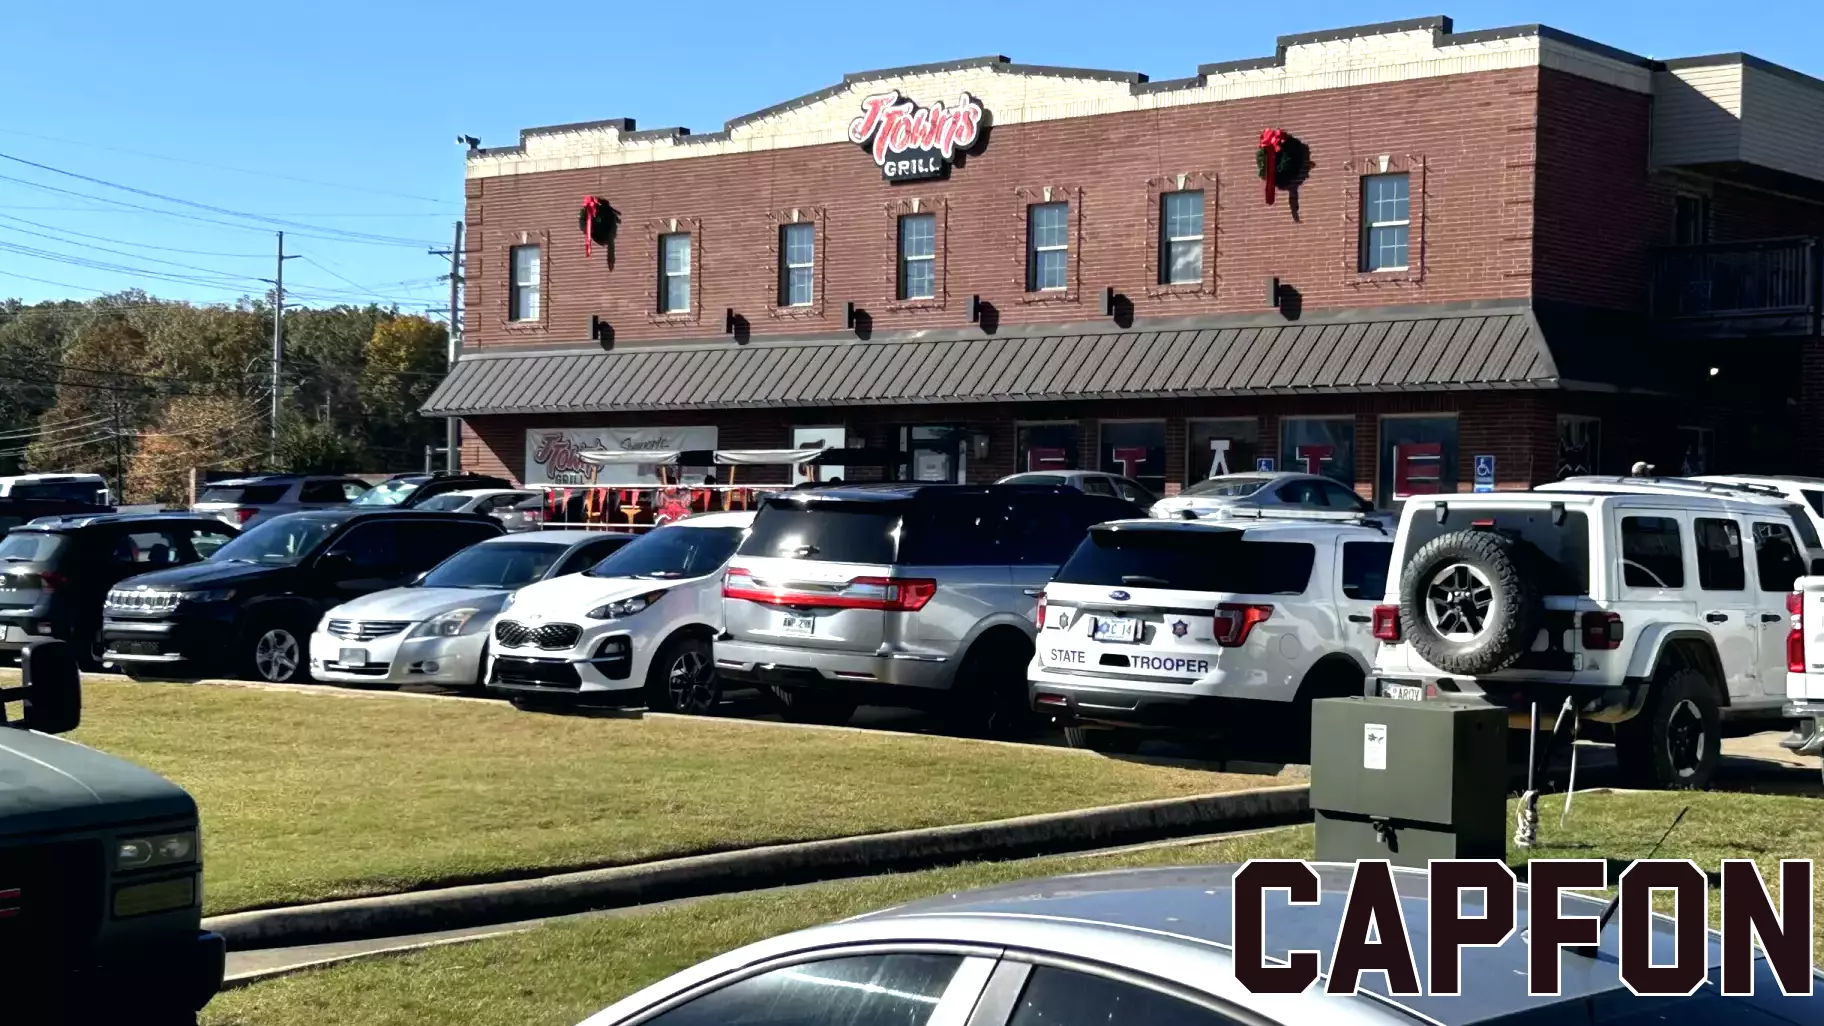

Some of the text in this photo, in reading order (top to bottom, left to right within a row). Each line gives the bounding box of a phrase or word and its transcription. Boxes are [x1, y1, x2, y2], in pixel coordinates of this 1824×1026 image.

[884, 157, 940, 176] GRILL
[1051, 648, 1209, 673] STATE TROOPER
